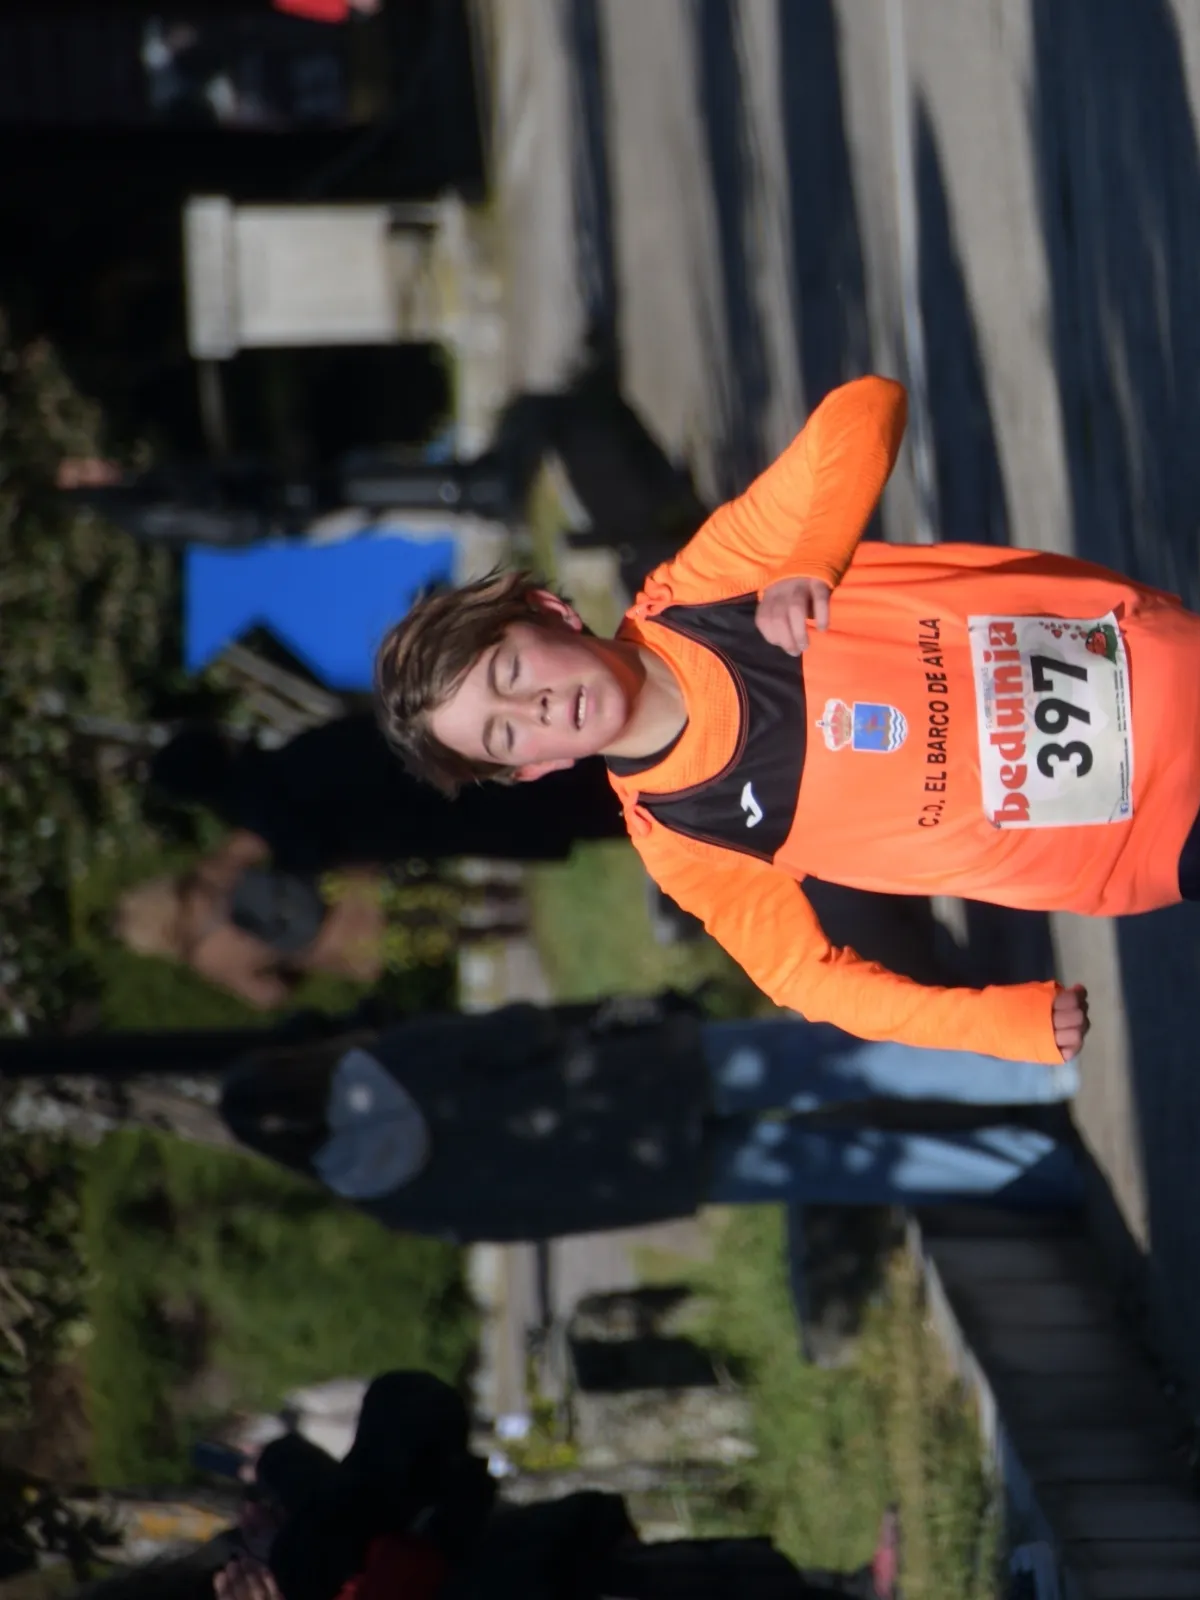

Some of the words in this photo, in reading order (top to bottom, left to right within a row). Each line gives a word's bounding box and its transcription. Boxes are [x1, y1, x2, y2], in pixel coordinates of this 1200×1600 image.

[917, 618, 944, 668] ÁVILA
[925, 672, 949, 694] DE
[926, 700, 950, 764] BARCO
[983, 620, 1031, 824] bedunia
[1029, 654, 1094, 779] 397
[924, 771, 947, 792] EL
[918, 799, 946, 827] C.D.
